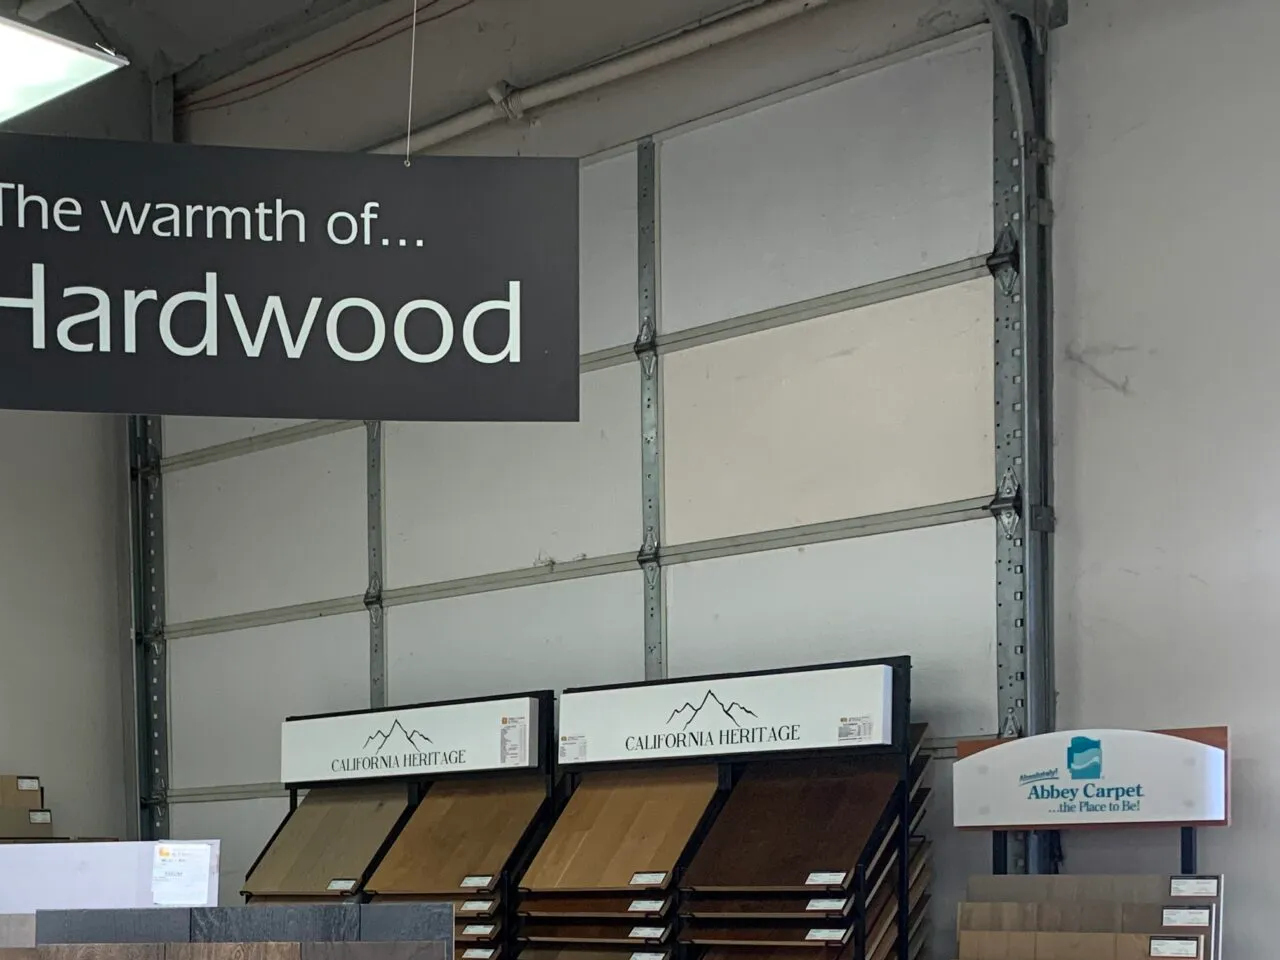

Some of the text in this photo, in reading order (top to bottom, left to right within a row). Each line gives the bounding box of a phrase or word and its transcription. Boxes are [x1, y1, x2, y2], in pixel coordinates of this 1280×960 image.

[99, 197, 308, 244] warmth
[326, 201, 425, 248] of...
[625, 724, 801, 752] CALIFORNIA HERITAGE
[331, 749, 467, 773] CALIFORNIA HERITAGE
[1027, 782, 1143, 801] Abbey Carpet
[1079, 800, 1106, 812] Place
[1108, 801, 1120, 812] to
[1122, 800, 1140, 812] Be!
